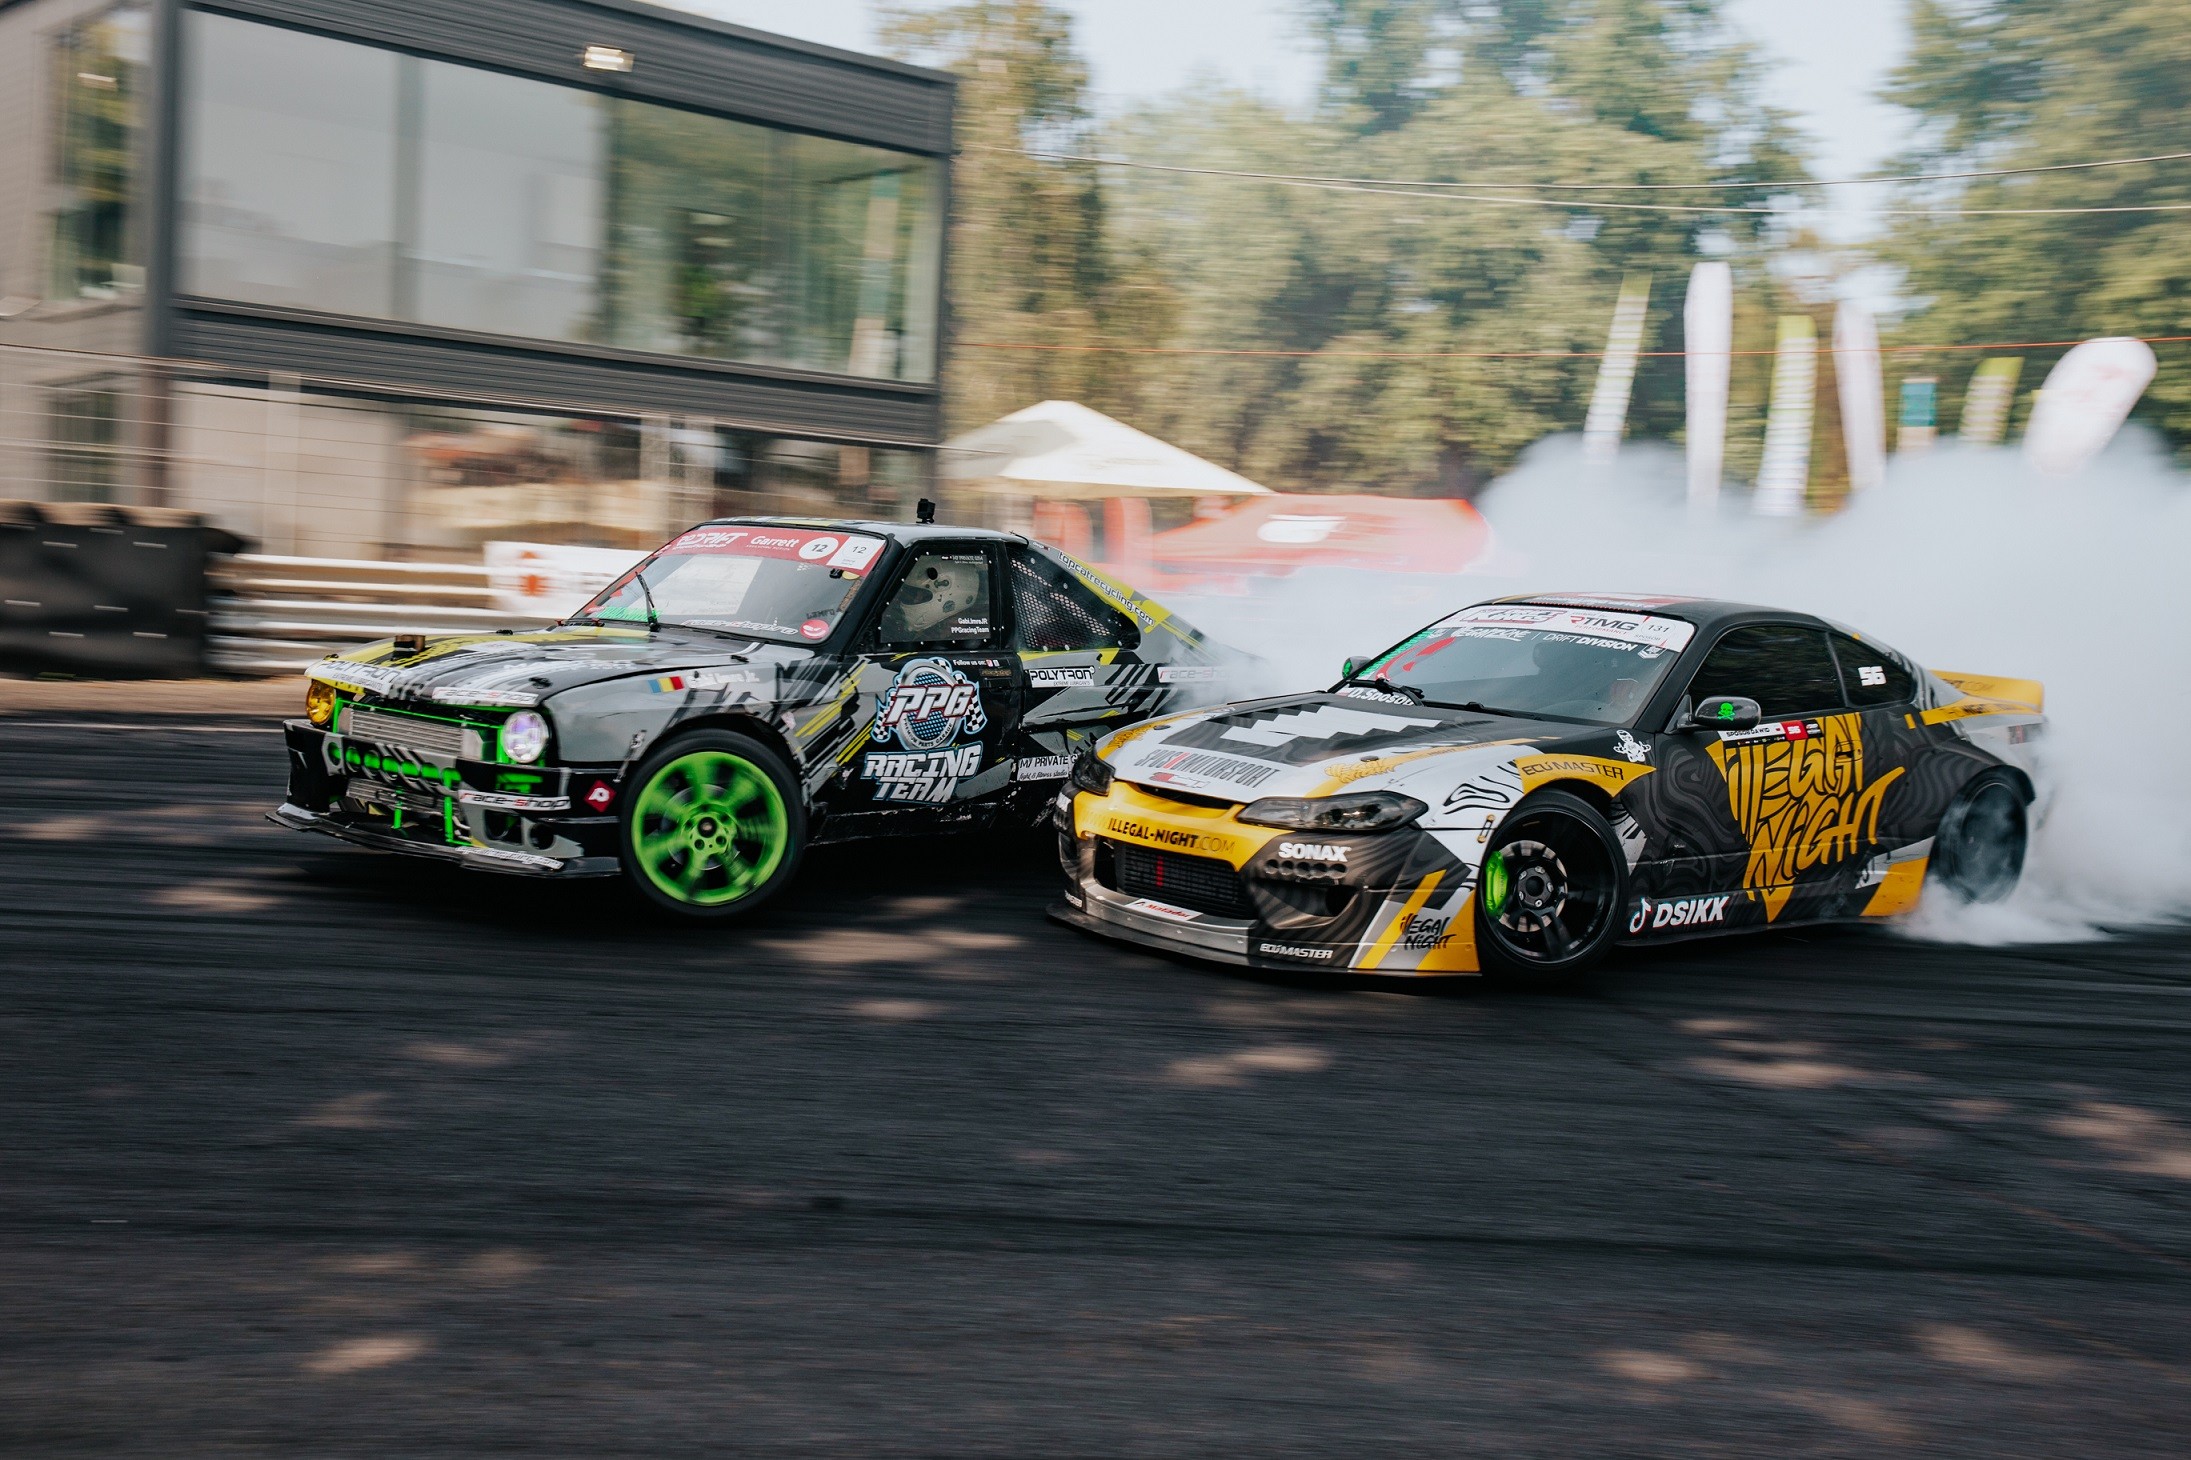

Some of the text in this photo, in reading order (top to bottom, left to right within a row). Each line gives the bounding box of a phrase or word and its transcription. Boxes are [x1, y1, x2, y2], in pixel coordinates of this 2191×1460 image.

[750, 536, 800, 548] Garrett
[811, 543, 825, 553] 12
[852, 545, 867, 555] 12
[1058, 551, 1155, 626] topcatrecycling.com
[1648, 624, 1670, 633] 131
[1031, 669, 1093, 680] POLYTRON
[1857, 666, 1887, 687] 56
[884, 685, 975, 723] PPG
[935, 723, 953, 744] GARAGE
[863, 744, 981, 777] RACING
[1034, 755, 1069, 767] PRIVATE
[876, 777, 958, 803] TEAM
[460, 792, 570, 808] race-shop
[1278, 842, 1350, 863] SONAX
[1146, 903, 1192, 918] Matador
[1653, 896, 1730, 929] DSIKK
